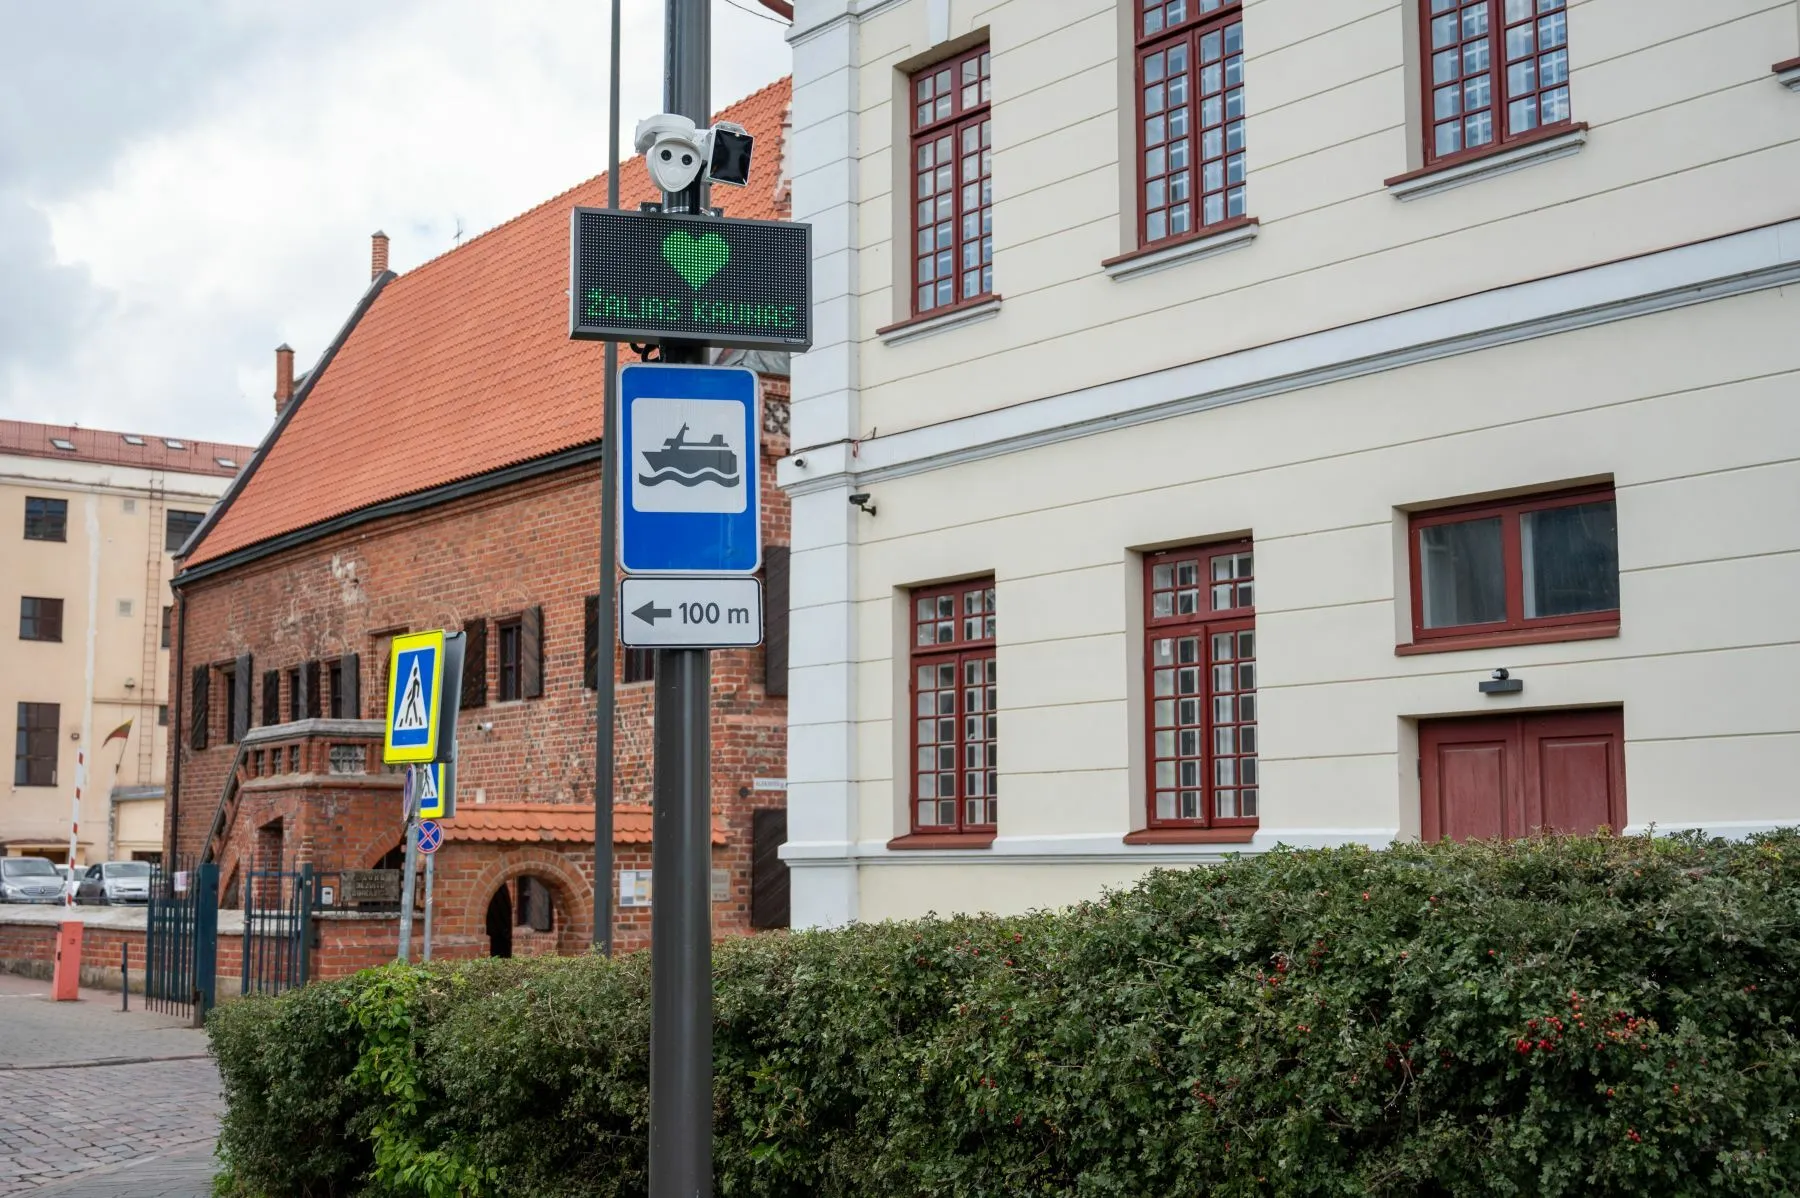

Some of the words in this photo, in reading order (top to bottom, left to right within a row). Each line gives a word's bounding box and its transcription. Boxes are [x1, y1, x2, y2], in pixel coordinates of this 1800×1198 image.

[586, 287, 680, 321] ŽALIAS
[692, 299, 796, 328] KAUNAS
[679, 602, 720, 625] 100
[727, 607, 750, 624] m
